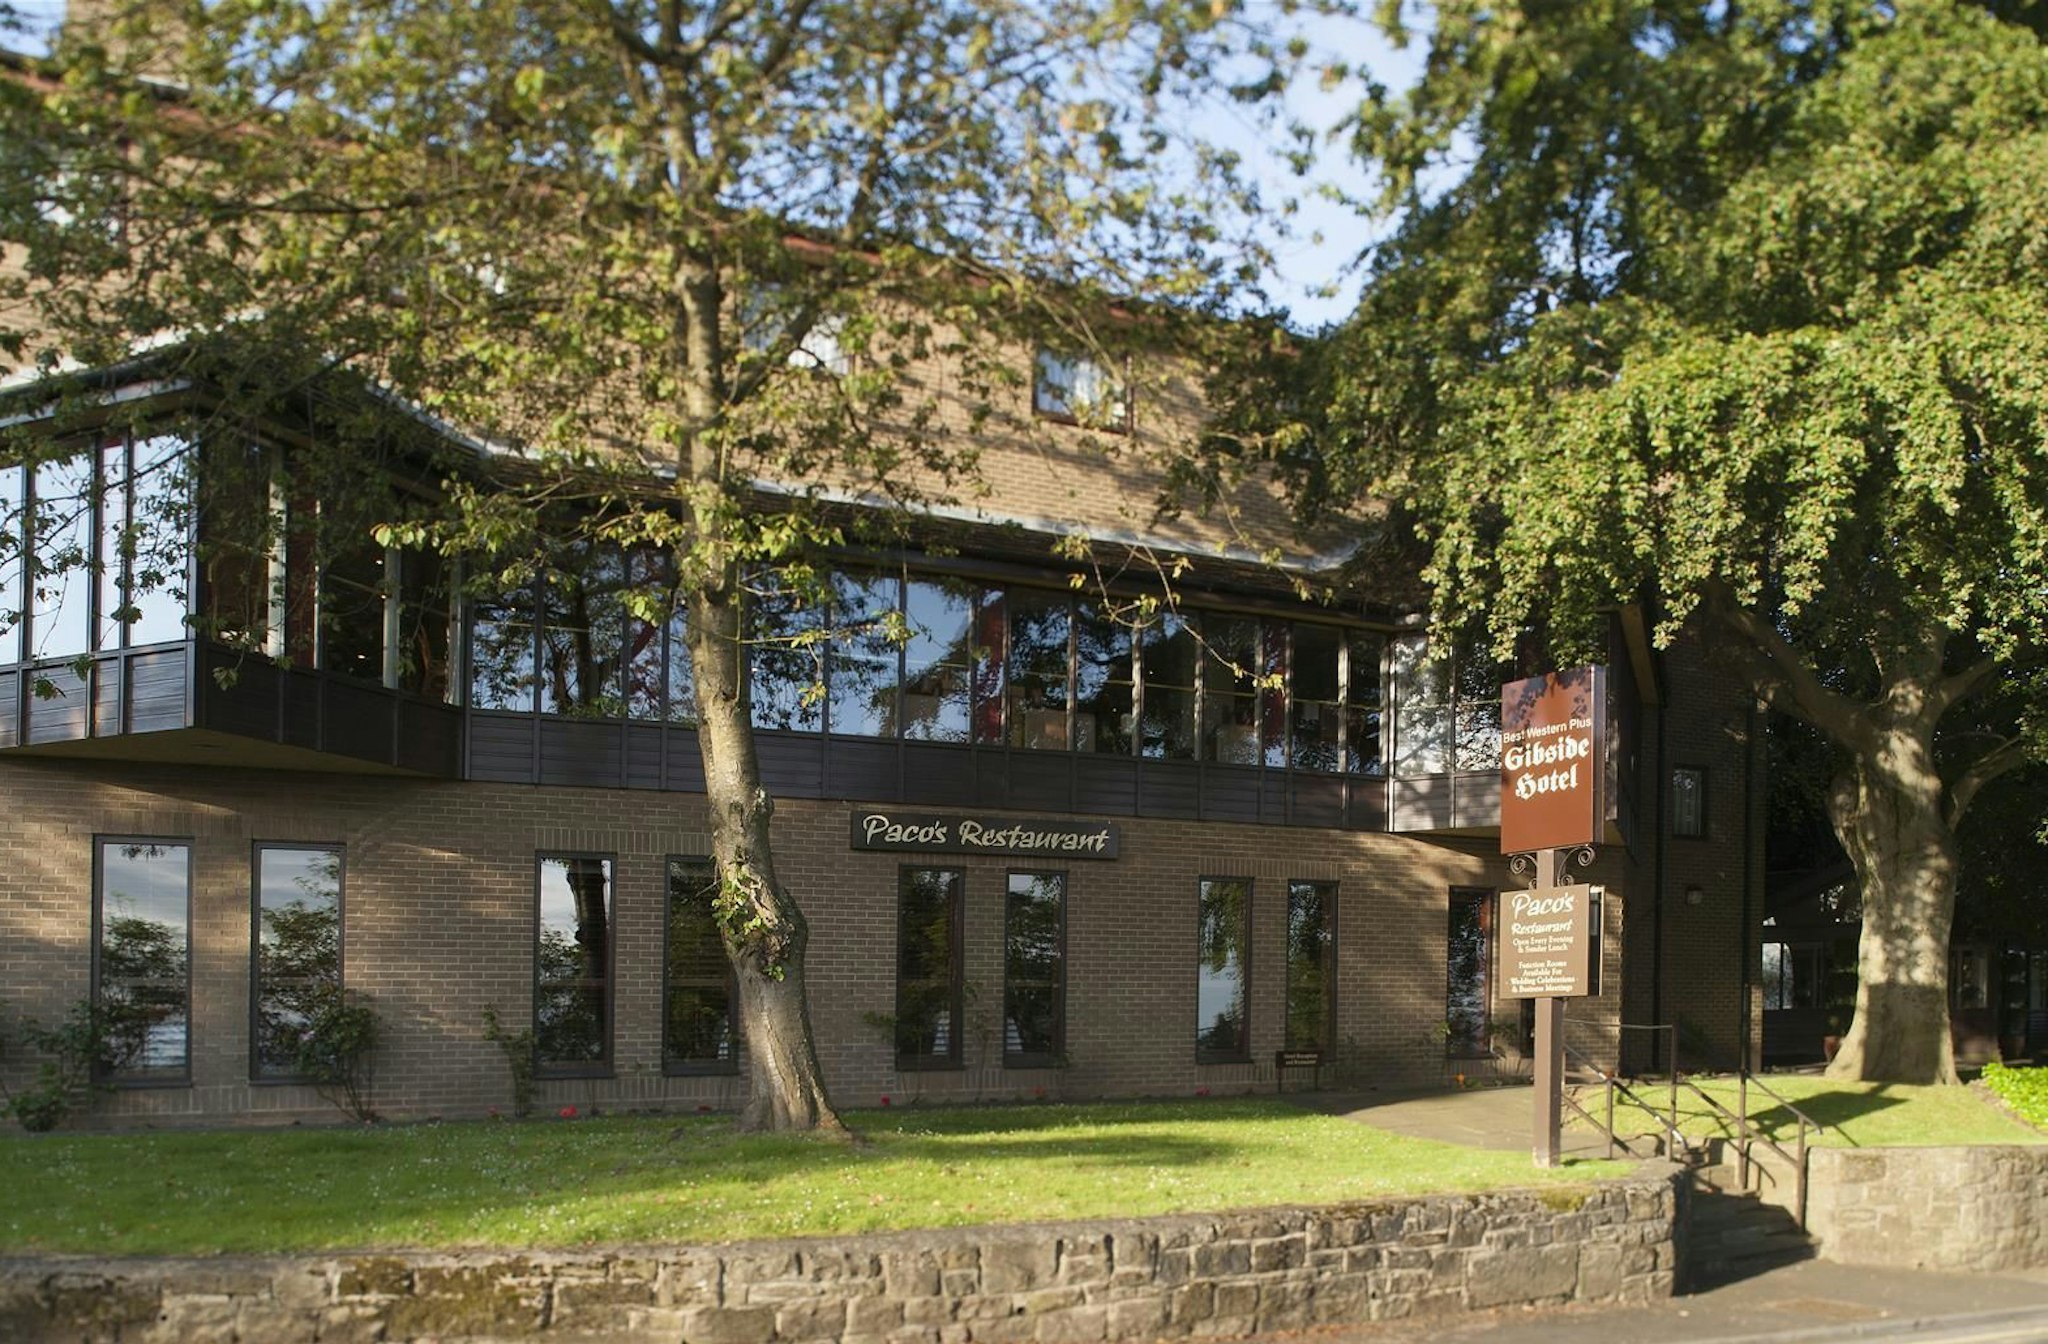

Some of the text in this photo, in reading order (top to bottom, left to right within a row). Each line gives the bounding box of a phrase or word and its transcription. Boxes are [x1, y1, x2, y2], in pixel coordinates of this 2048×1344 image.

[1503, 717, 1592, 744] Best Western Plus
[1504, 735, 1590, 771] Gibside
[1515, 763, 1578, 800] Hotel
[862, 814, 1109, 852] Paco's Restaurant
[1511, 892, 1575, 919] Paco's
[1511, 919, 1573, 935] Restaurant
[1513, 936, 1574, 946] Open Every Evening
[1548, 943, 1568, 951] Lunch
[1511, 977, 1536, 985] Wedding
[1523, 967, 1562, 976] Available For
